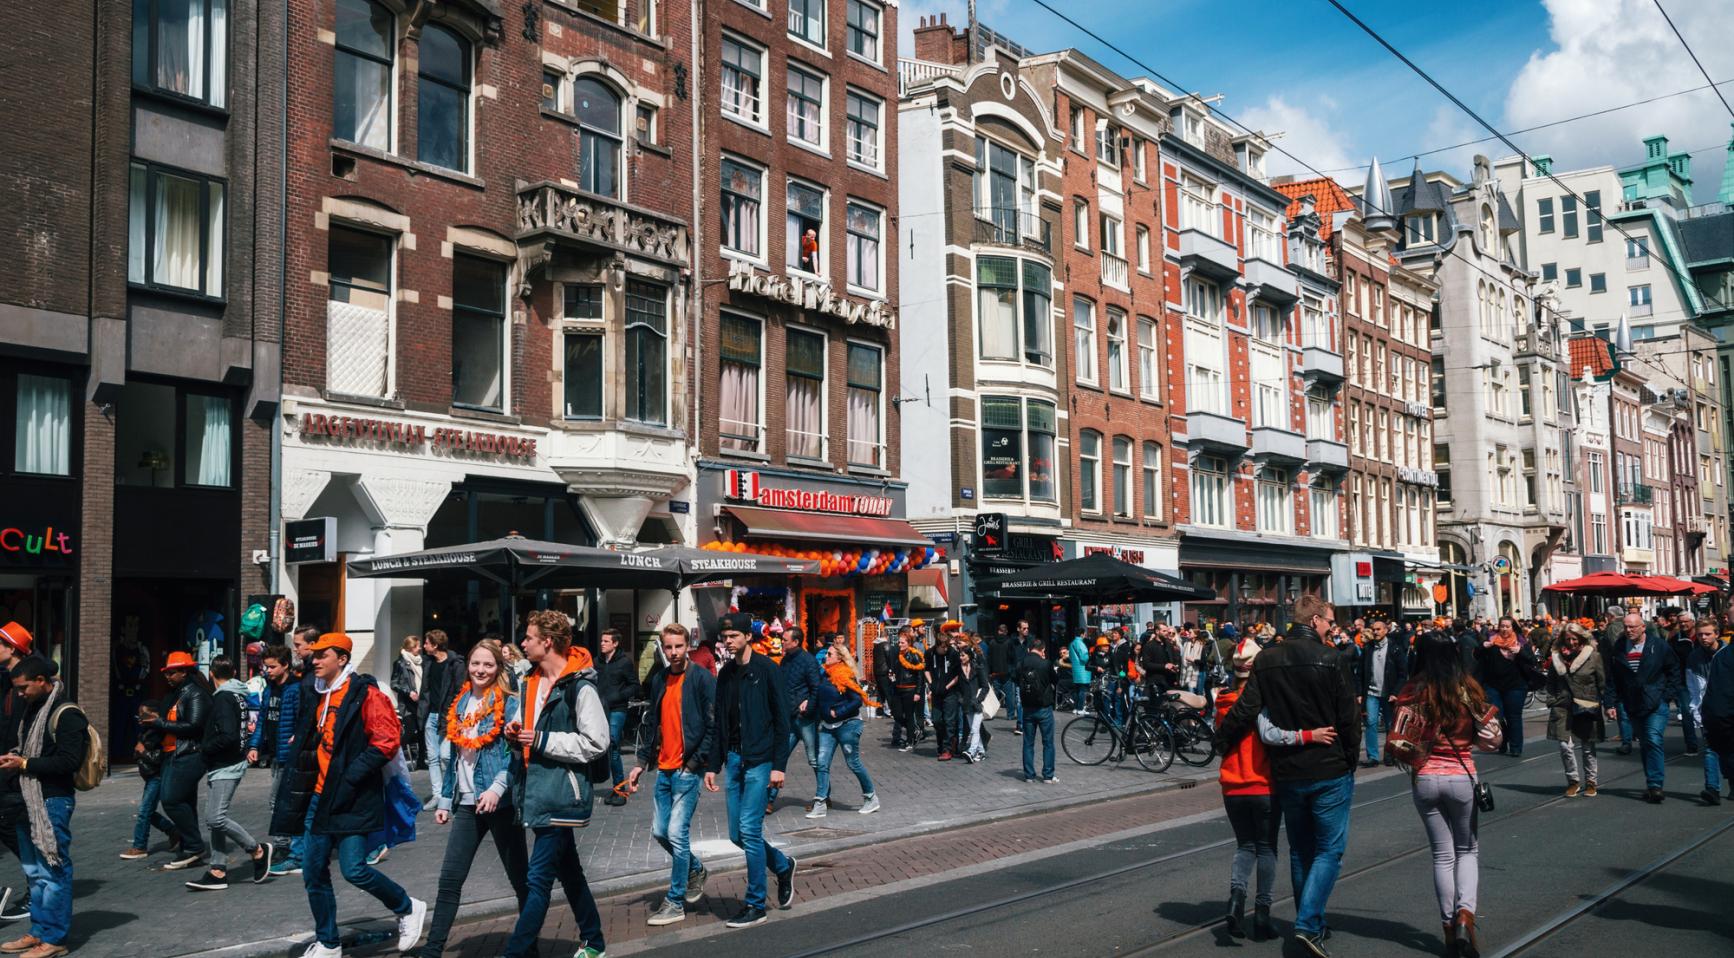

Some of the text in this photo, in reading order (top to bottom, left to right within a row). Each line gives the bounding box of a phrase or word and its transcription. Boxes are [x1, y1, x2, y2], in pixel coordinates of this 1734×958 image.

[729, 259, 803, 306] Hotel
[303, 412, 537, 458] ARGENTINIAN STEAKHOUSE
[372, 557, 402, 571] LUNCH
[412, 551, 477, 567] STEAKHOUSE
[620, 554, 662, 568] LUNCH
[690, 559, 757, 570] STEAKHOUSE
[1056, 578, 1097, 587] RESTAURANT
